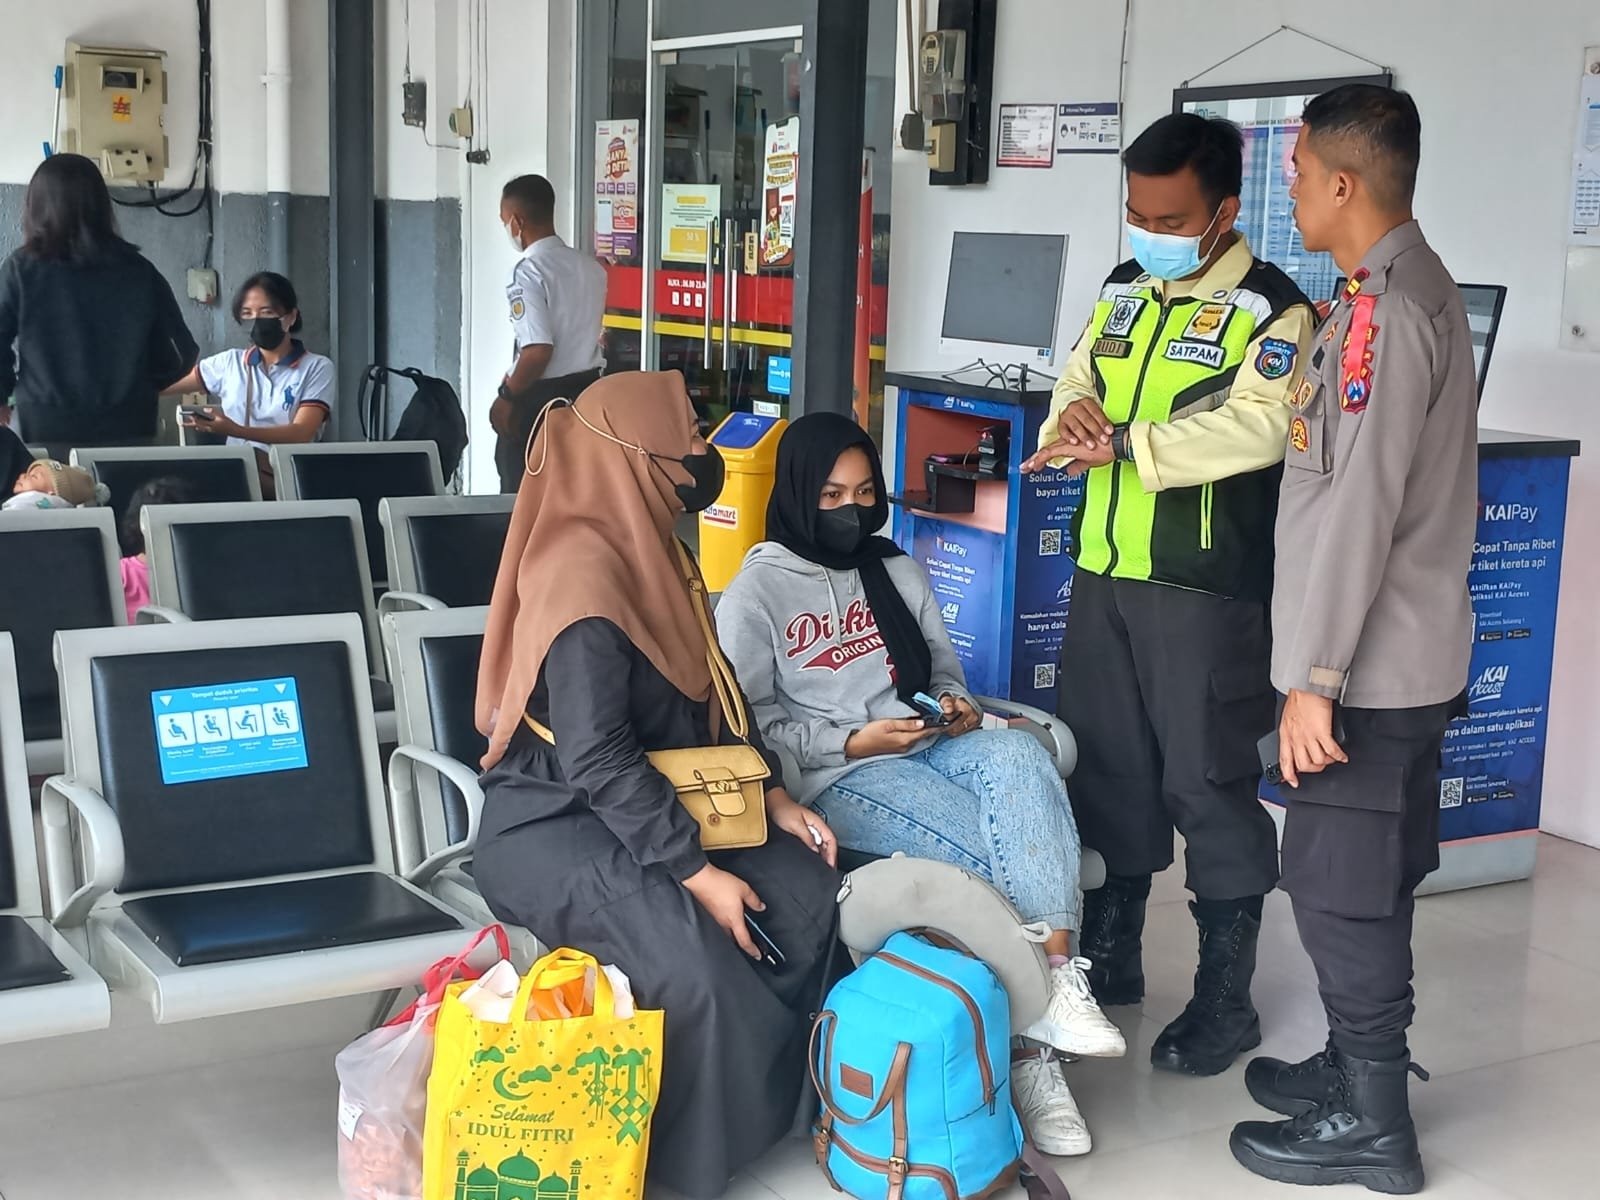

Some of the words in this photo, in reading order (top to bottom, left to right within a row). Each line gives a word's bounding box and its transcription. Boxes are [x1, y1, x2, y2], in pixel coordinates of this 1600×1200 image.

[1170, 344, 1219, 363] SATPAM
[1029, 473, 1055, 483] Solusi
[1036, 488, 1060, 498] bayar
[1061, 487, 1081, 497] tiket
[1484, 503, 1538, 523] KAIPay
[1472, 542, 1500, 554] Cepat
[1502, 540, 1530, 553] Tanpa
[1531, 538, 1556, 550] Ribet
[1477, 559, 1499, 571] tiket
[1500, 557, 1530, 569] kereta
[1531, 555, 1546, 570] api
[785, 599, 877, 659] Dicki
[1028, 622, 1050, 632] hanya
[1051, 620, 1067, 630] dala
[831, 634, 884, 663] ORIGIN
[1483, 665, 1509, 682] KAI
[1468, 674, 1505, 697] Access
[1443, 728, 1460, 739] nya
[1460, 725, 1486, 736] dalam
[1486, 721, 1504, 733] satu
[1505, 717, 1535, 732] aplikasi
[490, 1104, 555, 1123] Selamat
[468, 1121, 516, 1139] IDUL
[520, 1128, 574, 1141] FITRI
